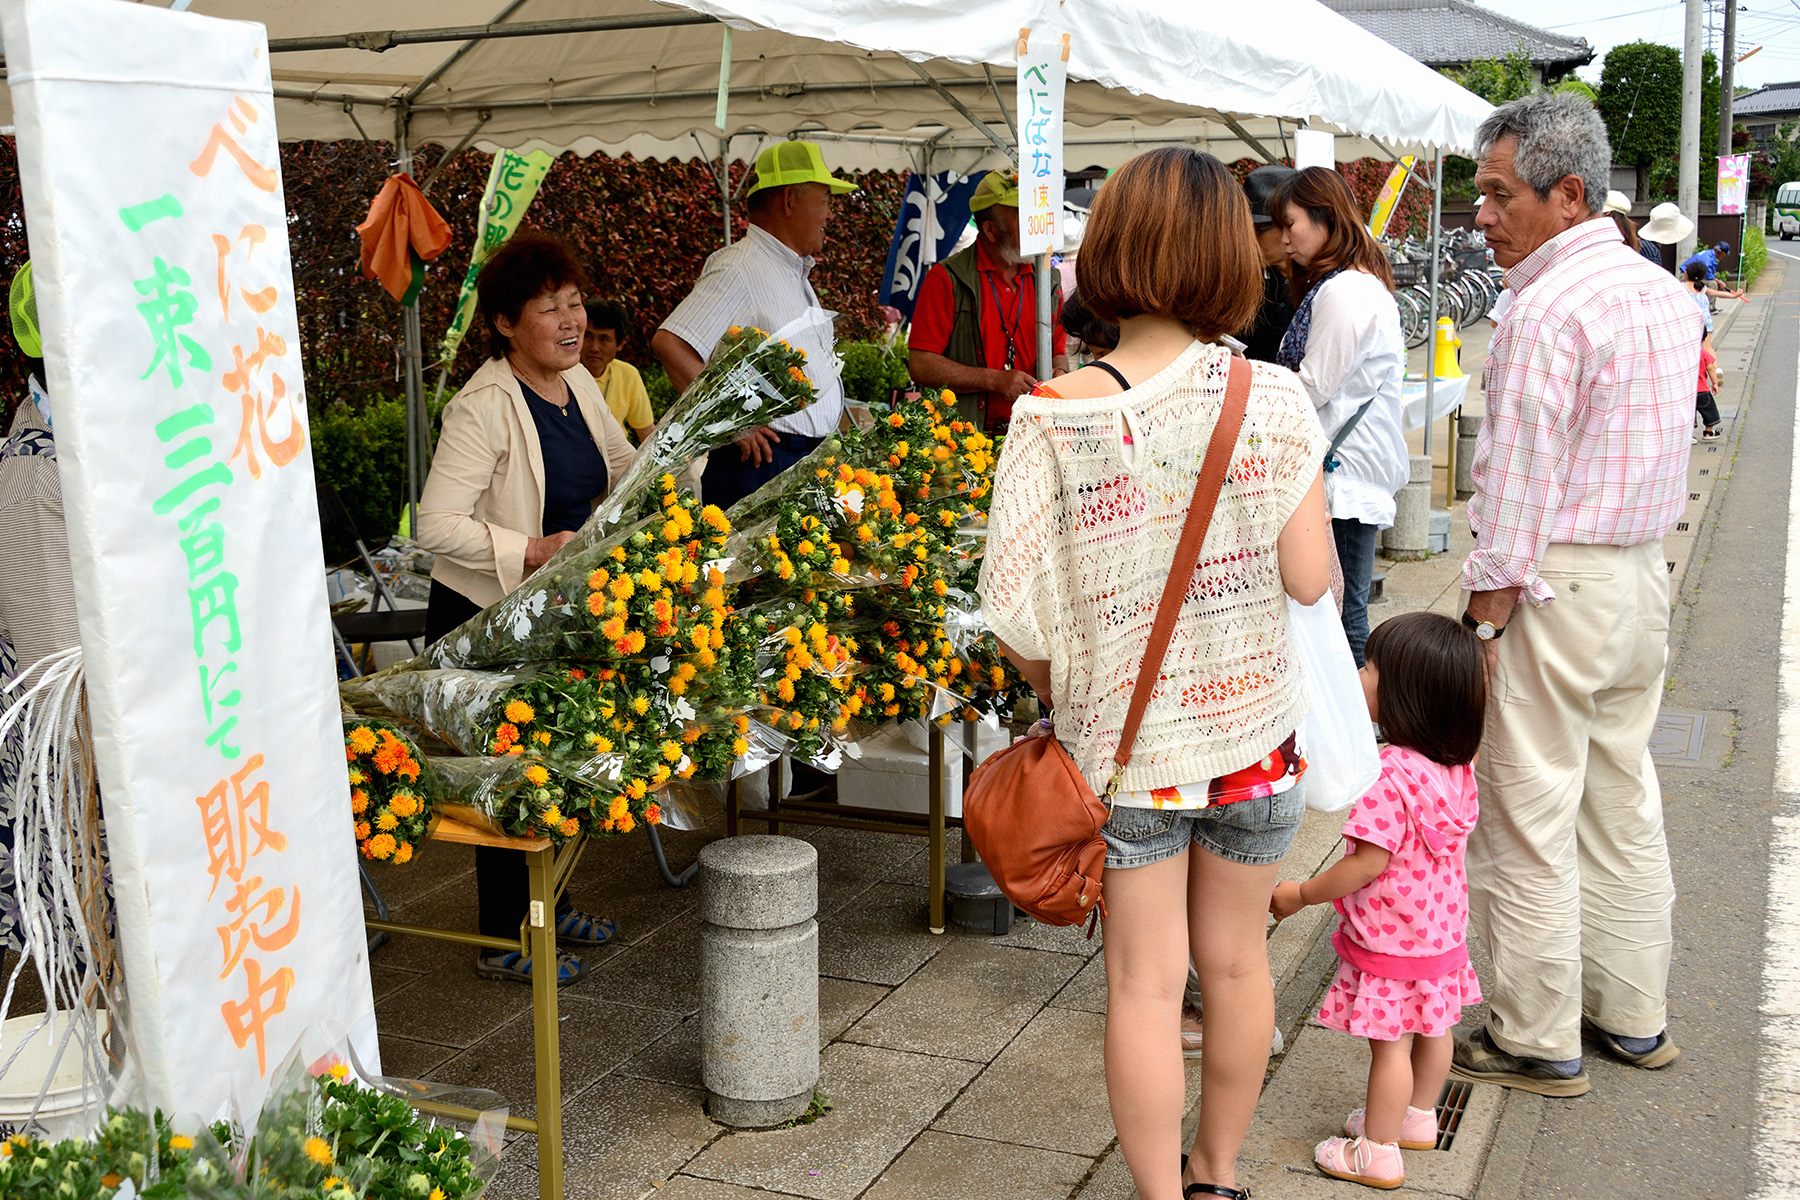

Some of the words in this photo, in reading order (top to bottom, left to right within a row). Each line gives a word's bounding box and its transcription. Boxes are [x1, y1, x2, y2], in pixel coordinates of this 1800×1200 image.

[1023, 63, 1053, 178] べにばな
[1027, 211, 1055, 236] 300円
[189, 95, 306, 480] べに花
[194, 752, 302, 1078] 販売中
